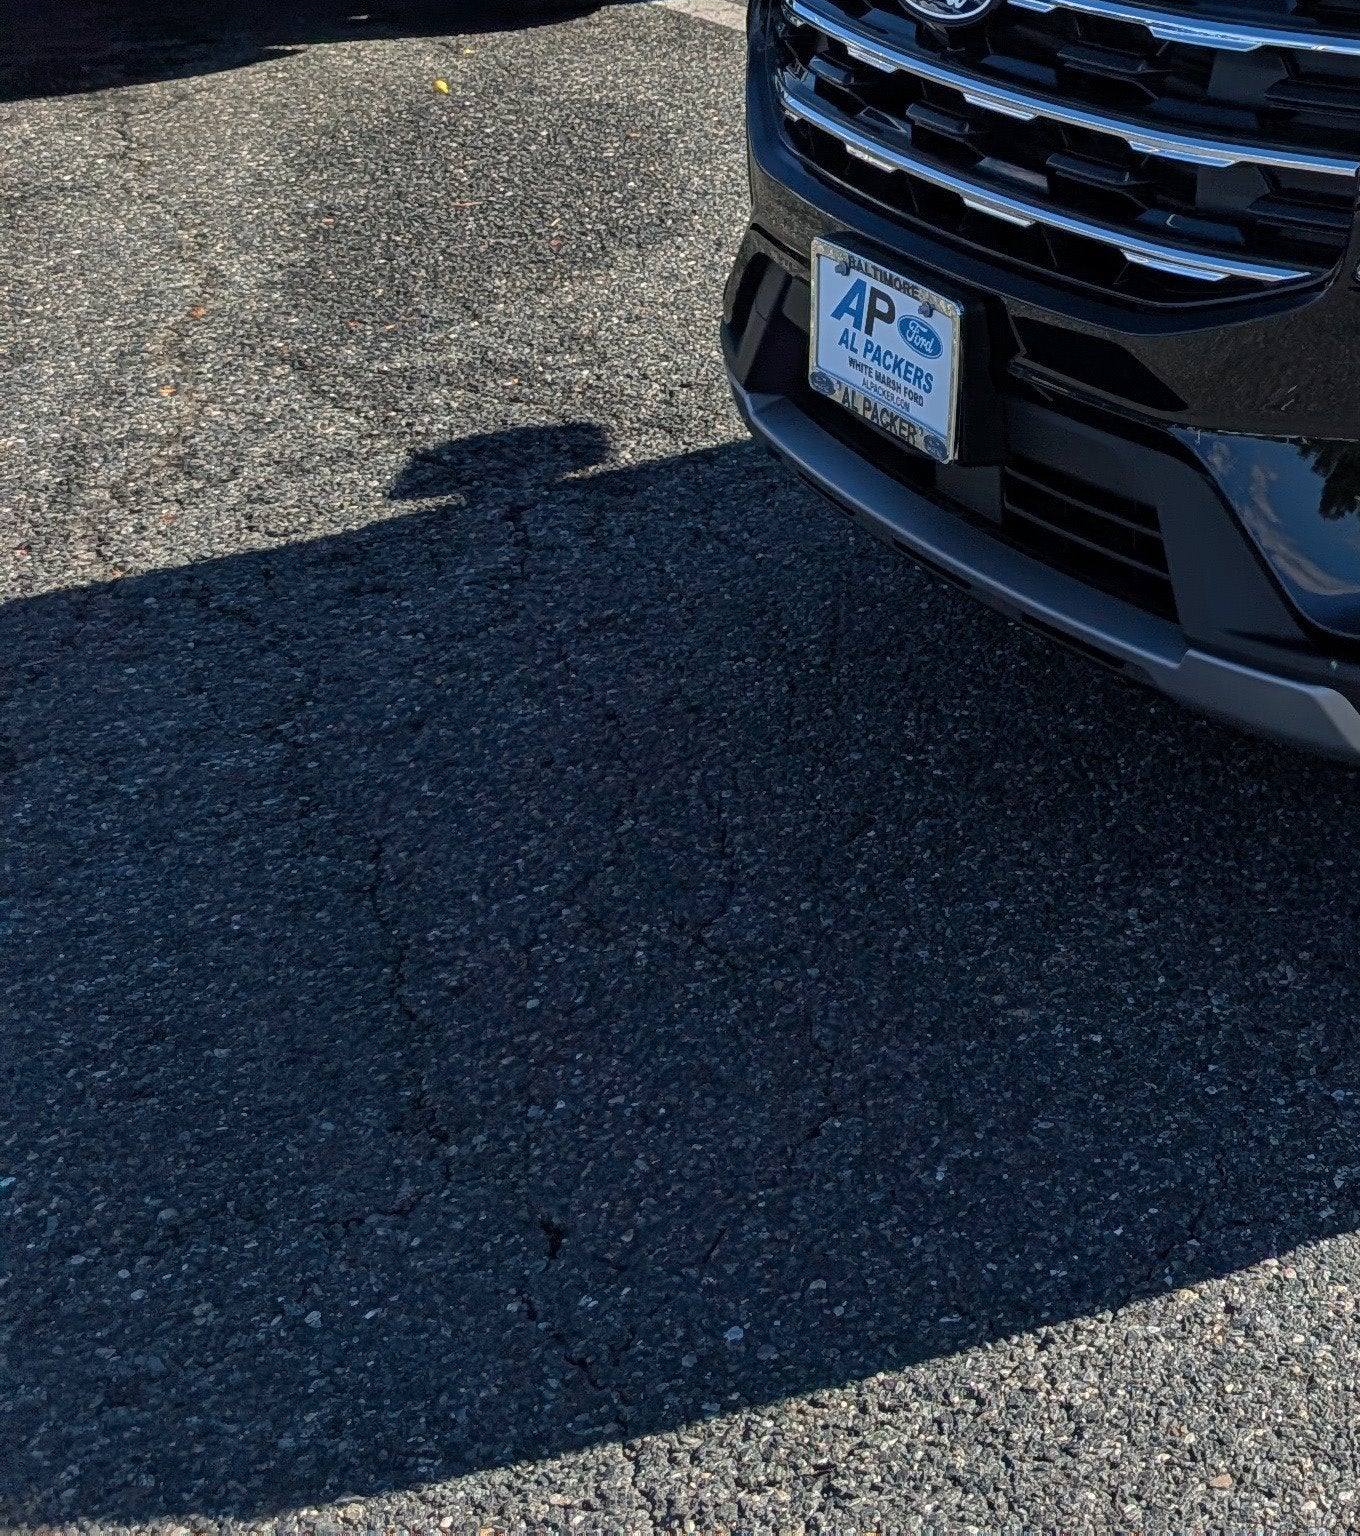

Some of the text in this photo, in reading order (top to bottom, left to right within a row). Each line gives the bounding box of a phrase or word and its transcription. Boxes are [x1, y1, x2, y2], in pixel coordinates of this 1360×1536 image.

[849, 254, 921, 301] BALTIMORE
[830, 277, 896, 338] AP
[837, 327, 859, 355] AL
[862, 340, 935, 394] PACKERS
[906, 319, 935, 355] Ford
[848, 356, 924, 407] WHITE MARSH FORD
[861, 378, 910, 413] ALPACKER.COM
